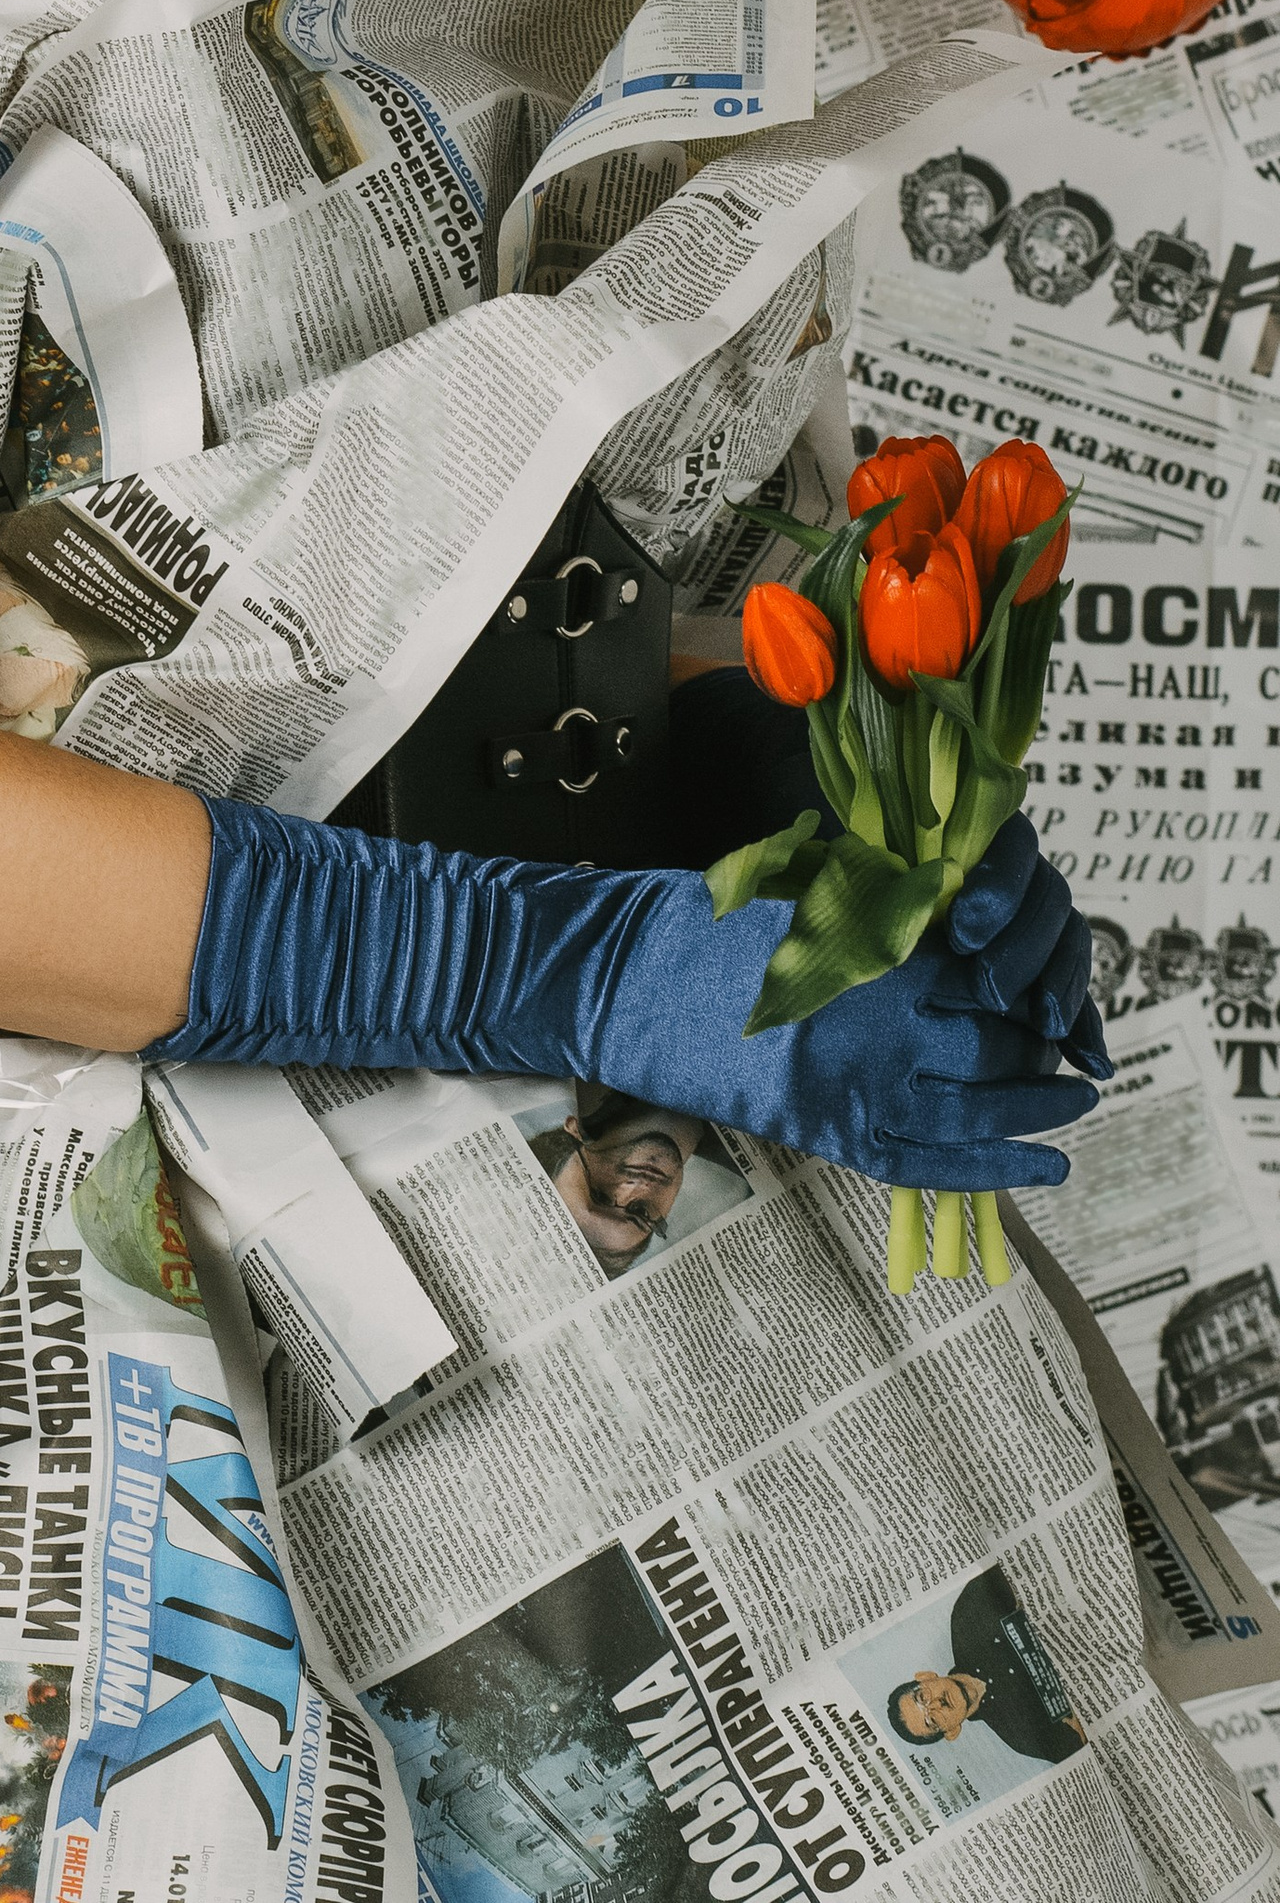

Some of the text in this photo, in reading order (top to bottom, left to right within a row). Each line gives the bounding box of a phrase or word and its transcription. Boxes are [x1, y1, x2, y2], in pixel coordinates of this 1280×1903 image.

[351, 50, 450, 141] ОЛИМПИАДА
[712, 95, 766, 121] 10
[339, 67, 481, 291] ВОРОБЬЕВЫ ГОРЫ
[351, 62, 484, 237] ШКОЛЬНИКОВ
[354, 180, 396, 250] 19 января
[364, 173, 416, 257] МГУ «МК»
[376, 166, 424, 245] совместной
[386, 160, 455, 280] Отборочный этап
[847, 350, 1230, 506] Касается каждого
[892, 335, 1218, 452] Адреса сопротивления
[21, 550, 160, 658] Что такое мизогиния
[47, 537, 174, 634] часто маскируется
[51, 558, 159, 636] почему она так
[54, 526, 181, 625] под комплименты
[240, 593, 311, 632] этого можно»
[1234, 768, 1263, 791] и
[15, 1138, 42, 1217] «полевой
[248, 1245, 333, 1366] Российский рынок труда
[21, 1249, 92, 1642] ВКУСНЫЕ ТАНКИ
[97, 1462, 168, 1729] ПРОГРАММА
[1228, 1615, 1261, 1641] 5
[633, 1515, 827, 1831] СУПЕРАГЕНТА
[290, 1693, 325, 1848] МОСКОВСКИЙ
[779, 1703, 892, 1868] Диссиденты «объявили
[798, 1696, 907, 1857] войну» Центральному
[822, 1696, 924, 1849] разведывательному
[846, 1708, 940, 1838] управлению США
[932, 1792, 954, 1819] 1994
[952, 1763, 982, 1803] ареста.
[105, 1810, 120, 1862] ИЗДАЕТСЯ
[792, 1824, 866, 1894] ОТ
